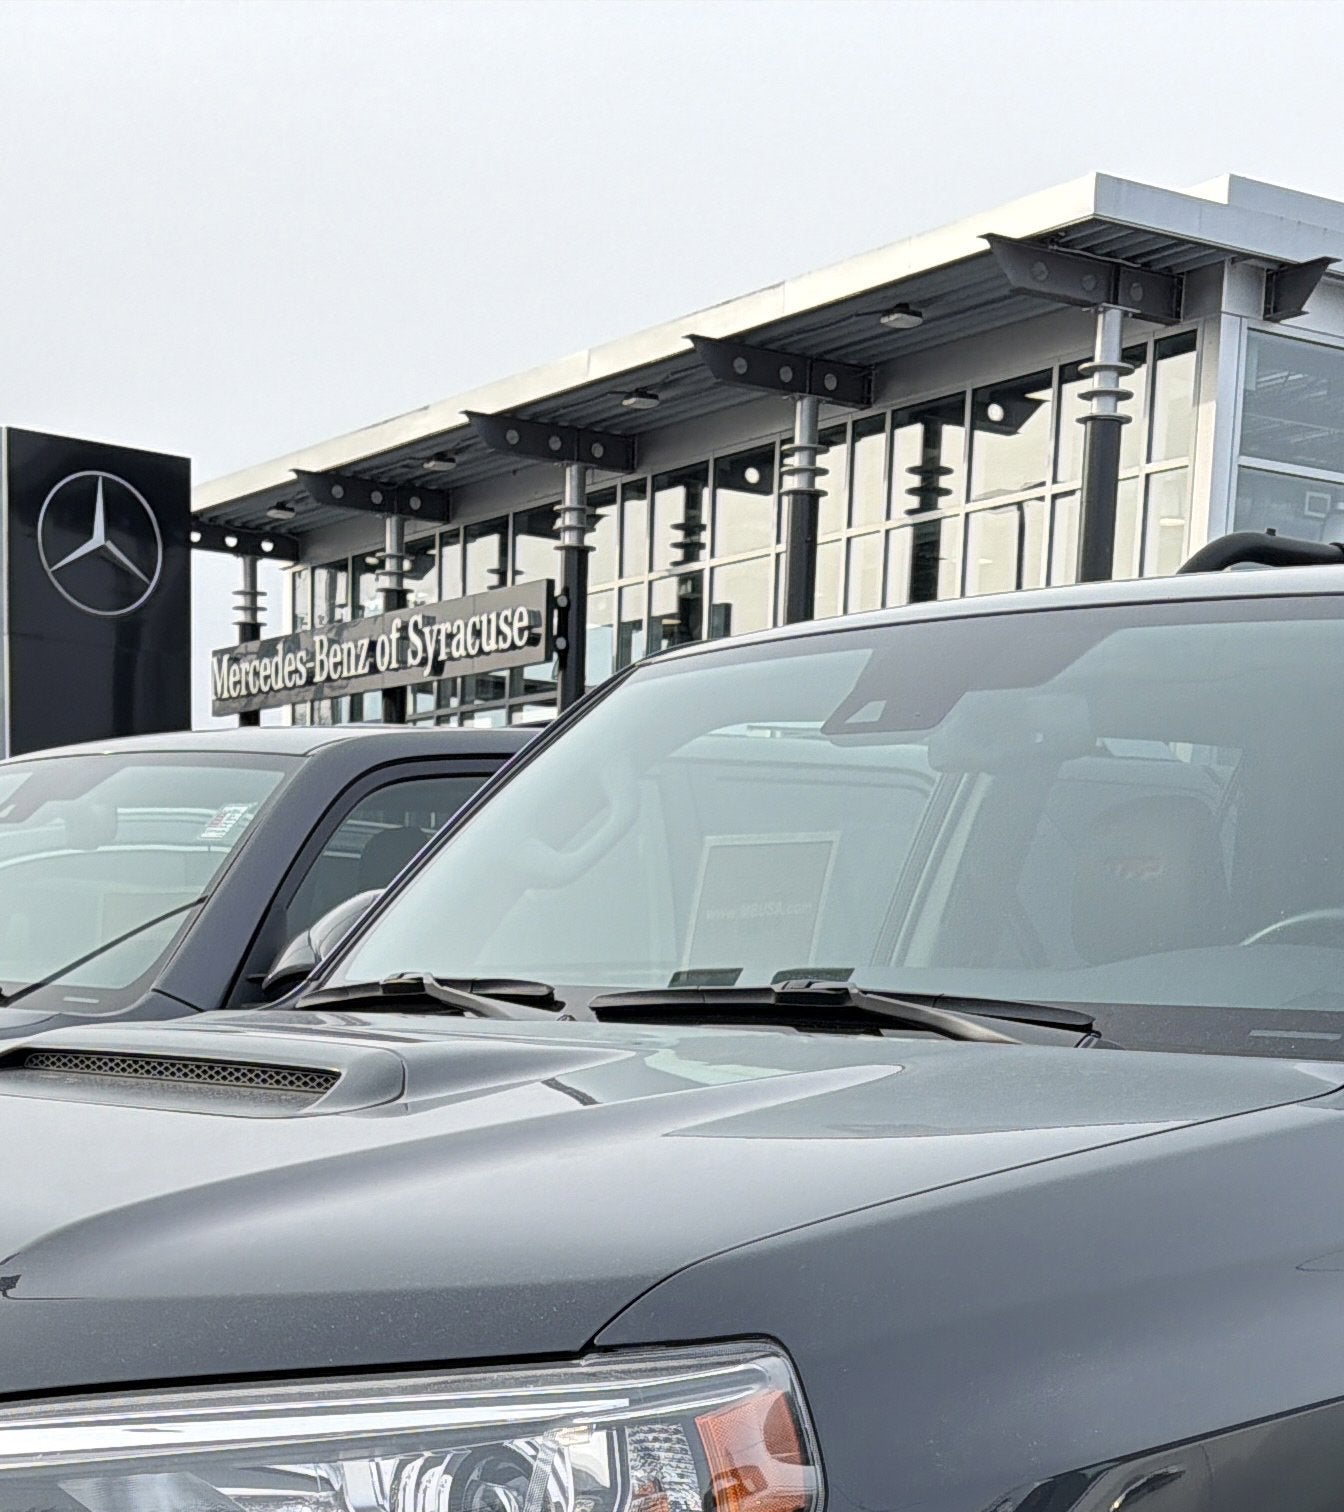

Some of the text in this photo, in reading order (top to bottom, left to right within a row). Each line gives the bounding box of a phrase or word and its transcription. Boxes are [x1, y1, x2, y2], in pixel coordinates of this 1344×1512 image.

[211, 605, 530, 699] Mercedes-Benz of Syracuse
